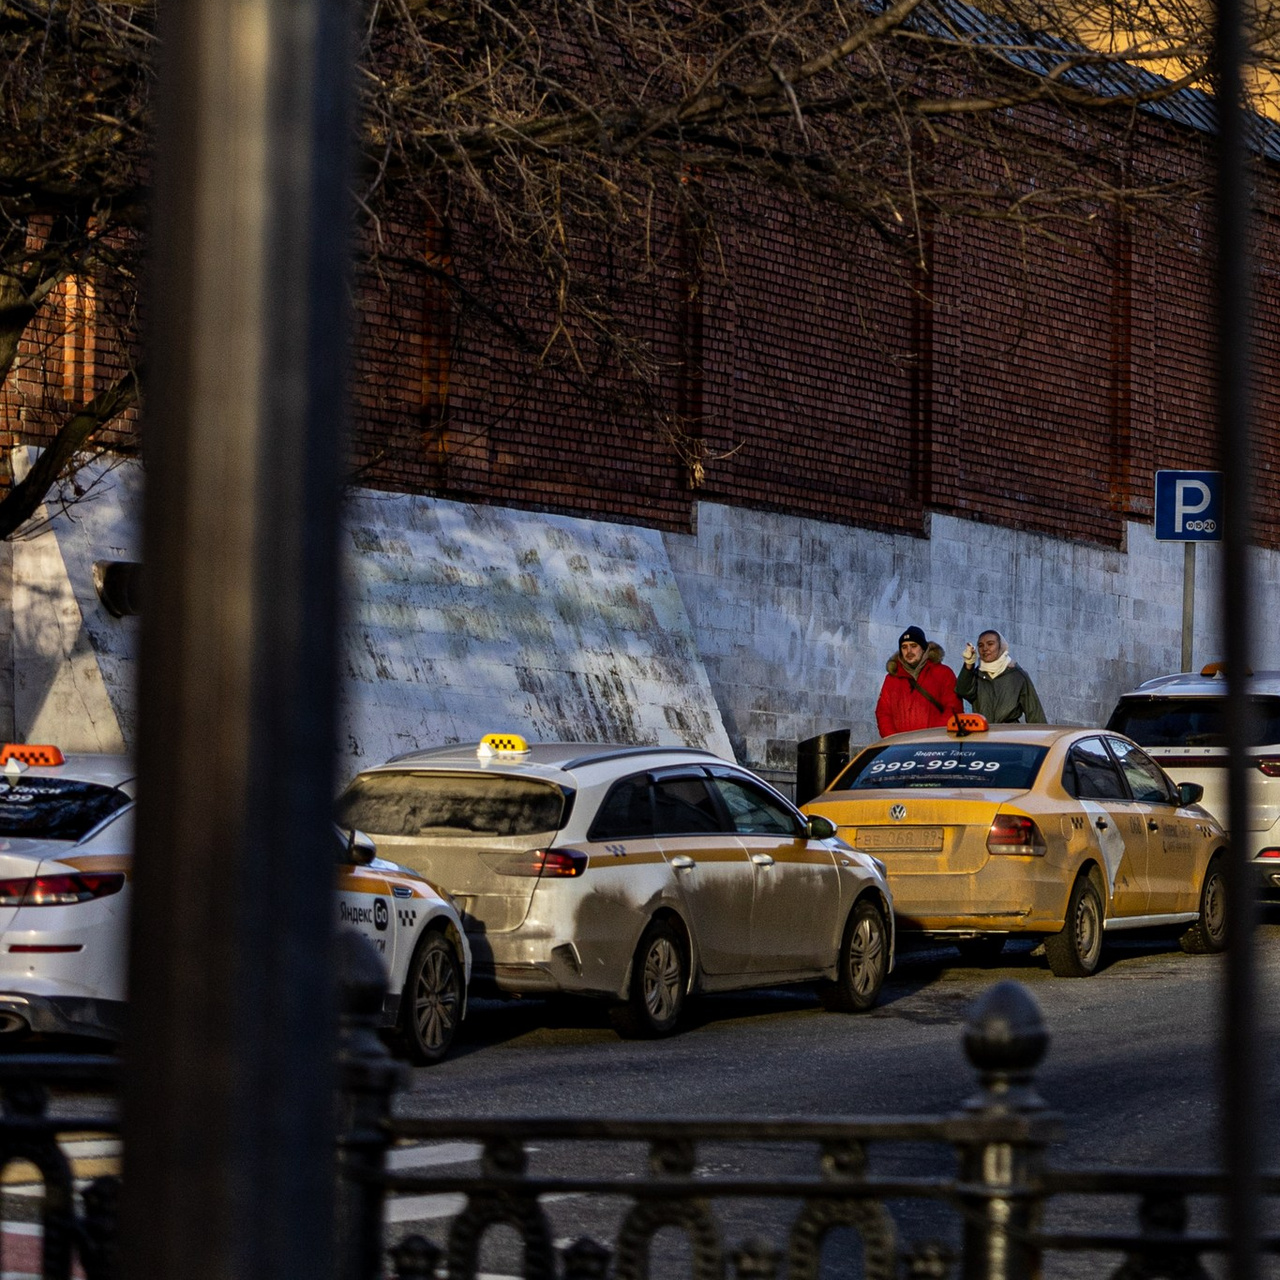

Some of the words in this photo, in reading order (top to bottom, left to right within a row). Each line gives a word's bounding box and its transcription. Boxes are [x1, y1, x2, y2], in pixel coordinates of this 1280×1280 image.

[1174, 479, 1212, 533] P
[1204, 521, 1216, 530] 20
[913, 750, 947, 759] Яндекс
[949, 749, 976, 758] Такси
[870, 759, 1001, 774] 999-99-99
[340, 901, 373, 924] Яндекс
[375, 902, 388, 924] Go
